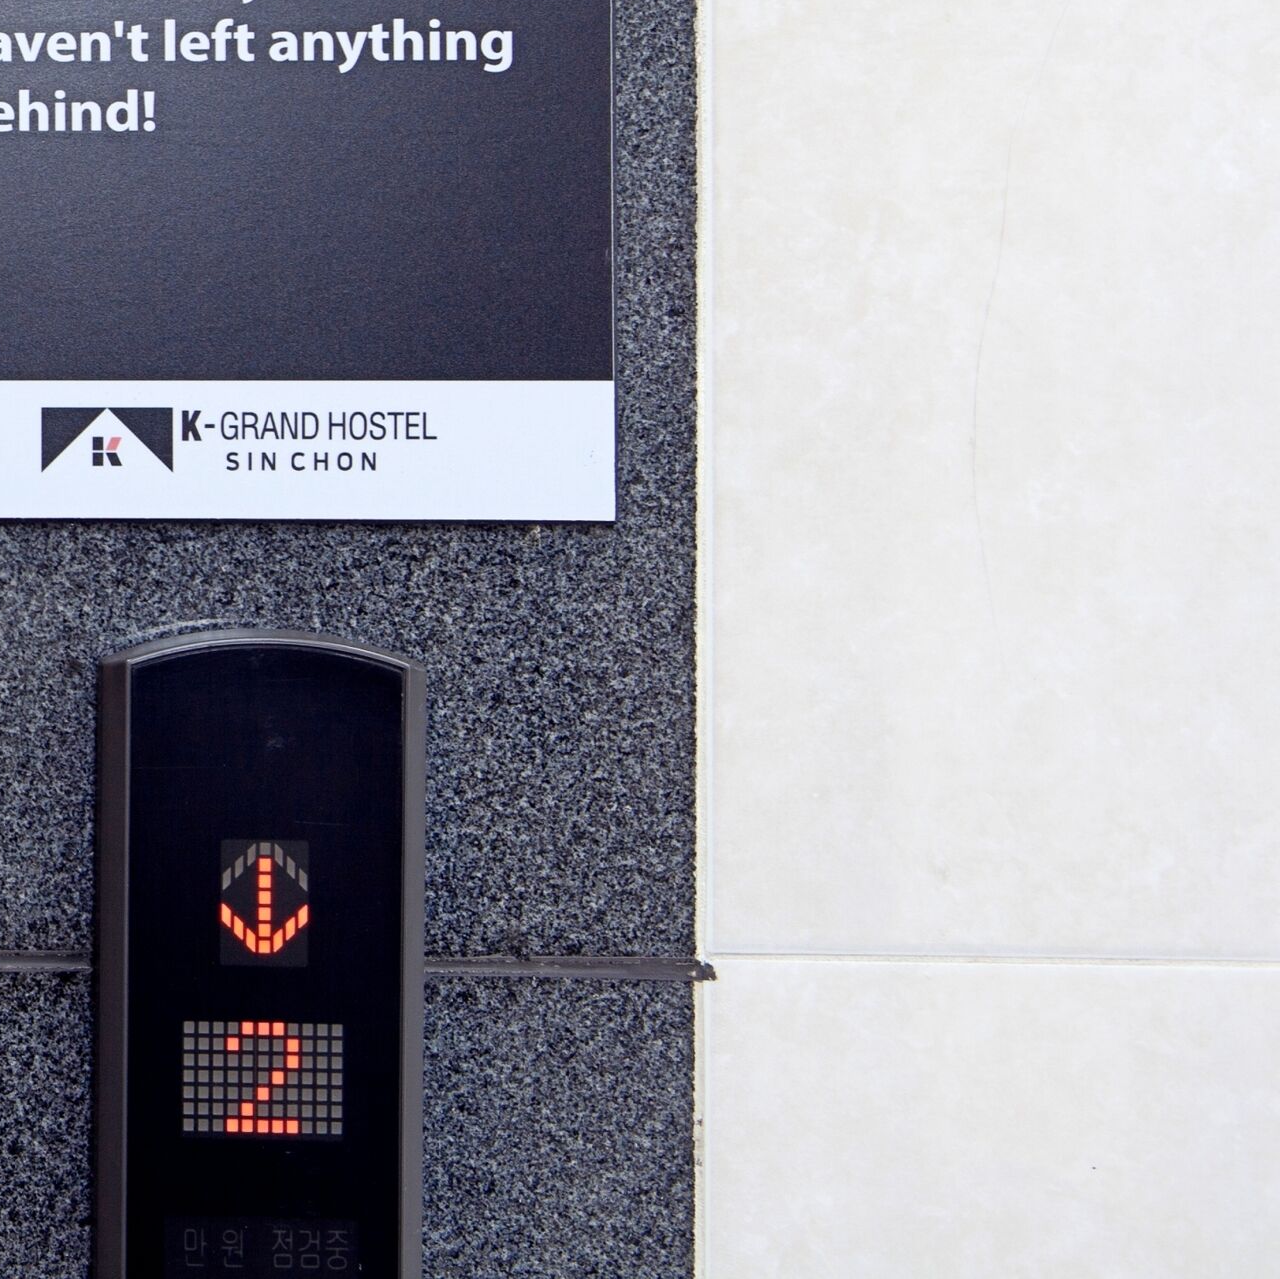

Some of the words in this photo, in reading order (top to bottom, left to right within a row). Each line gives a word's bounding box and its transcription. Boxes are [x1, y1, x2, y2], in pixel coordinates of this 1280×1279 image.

[164, 18, 255, 62] left
[268, 18, 514, 74] anything
[181, 410, 319, 442] K-GRAND
[328, 411, 438, 441] HOSTEL
[91, 435, 123, 467] K
[226, 1021, 300, 1134] 2
[270, 1229, 349, 1270] 점검중
